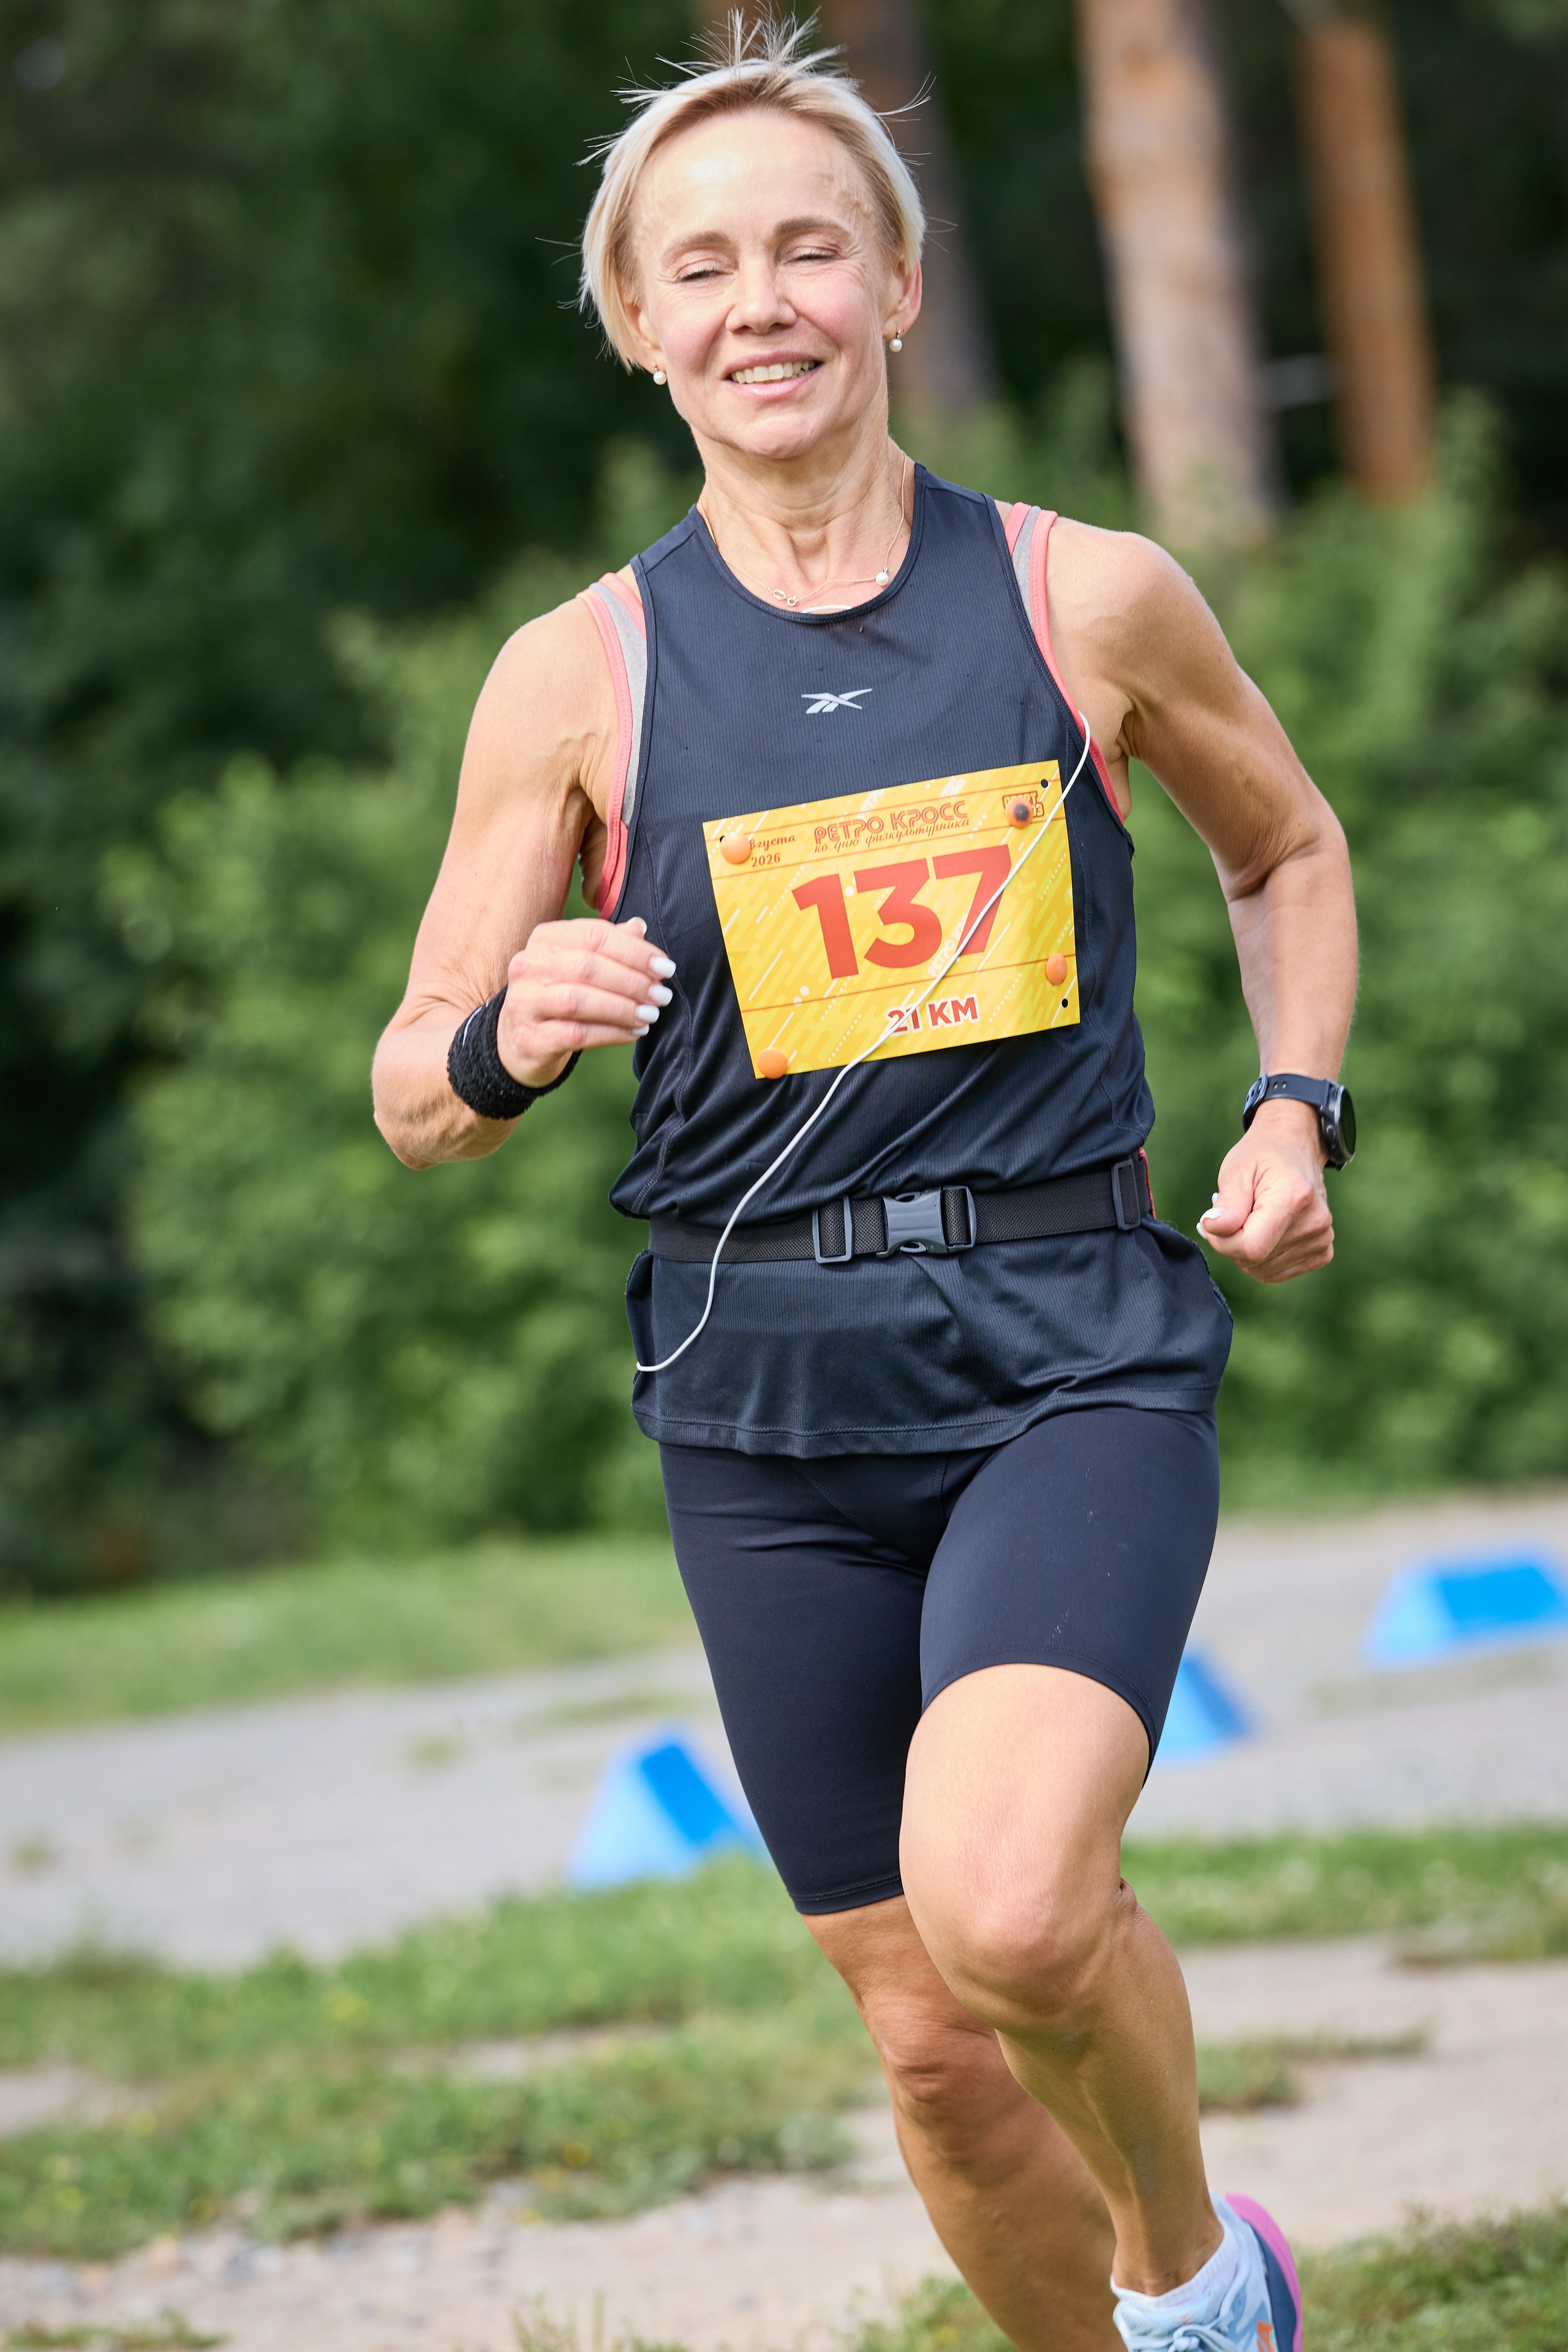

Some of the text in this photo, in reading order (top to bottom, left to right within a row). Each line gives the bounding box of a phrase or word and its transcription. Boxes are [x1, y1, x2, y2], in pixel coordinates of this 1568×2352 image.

[814, 816, 884, 845] РЕТРО
[890, 800, 968, 831] КРОСС
[815, 843, 827, 853] ко
[865, 818, 970, 847] физкультурника
[750, 835, 797, 851] вгуста
[752, 852, 780, 868] 2026
[791, 844, 1012, 979] 137
[888, 1007, 920, 1033] 21
